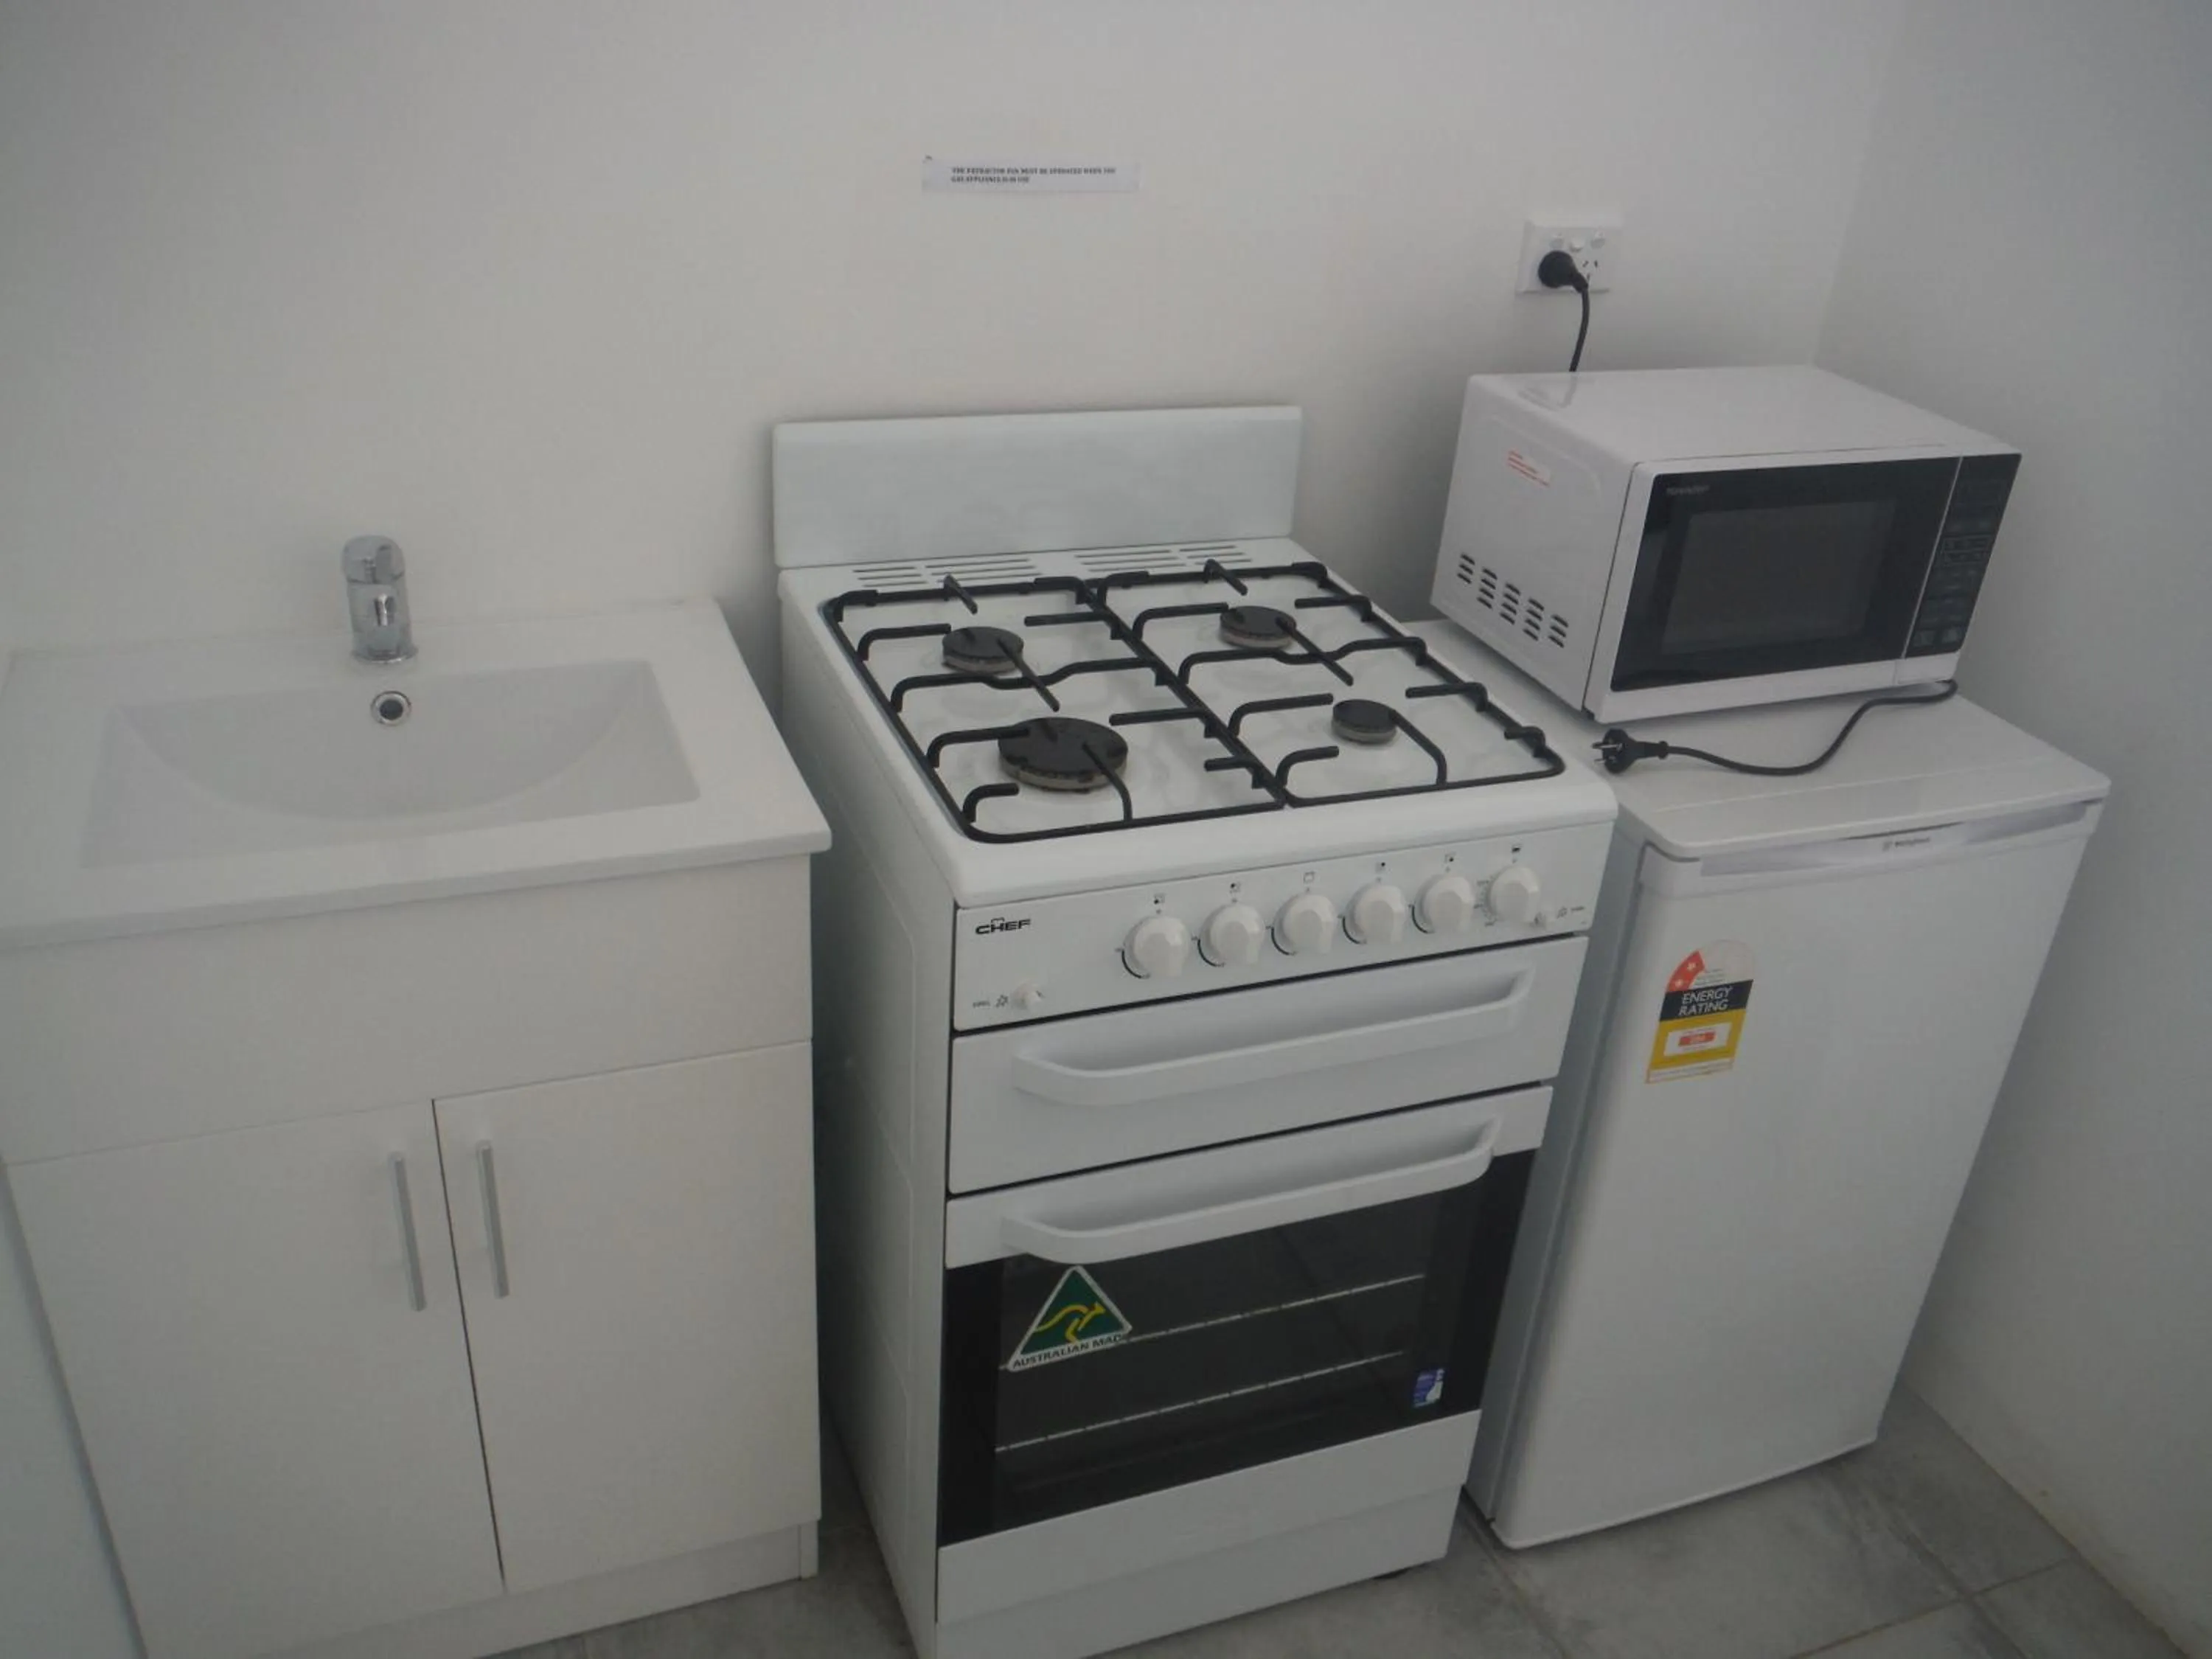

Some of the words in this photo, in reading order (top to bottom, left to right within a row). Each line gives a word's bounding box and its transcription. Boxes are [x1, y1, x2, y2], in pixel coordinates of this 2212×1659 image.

[975, 917, 1031, 934] CHEF
[1682, 986, 1733, 1004] ENERGY
[1678, 999, 1728, 1016] RATING
[1013, 1342, 1089, 1369] AUSTRALIAN
[1093, 1332, 1126, 1348] MAD
